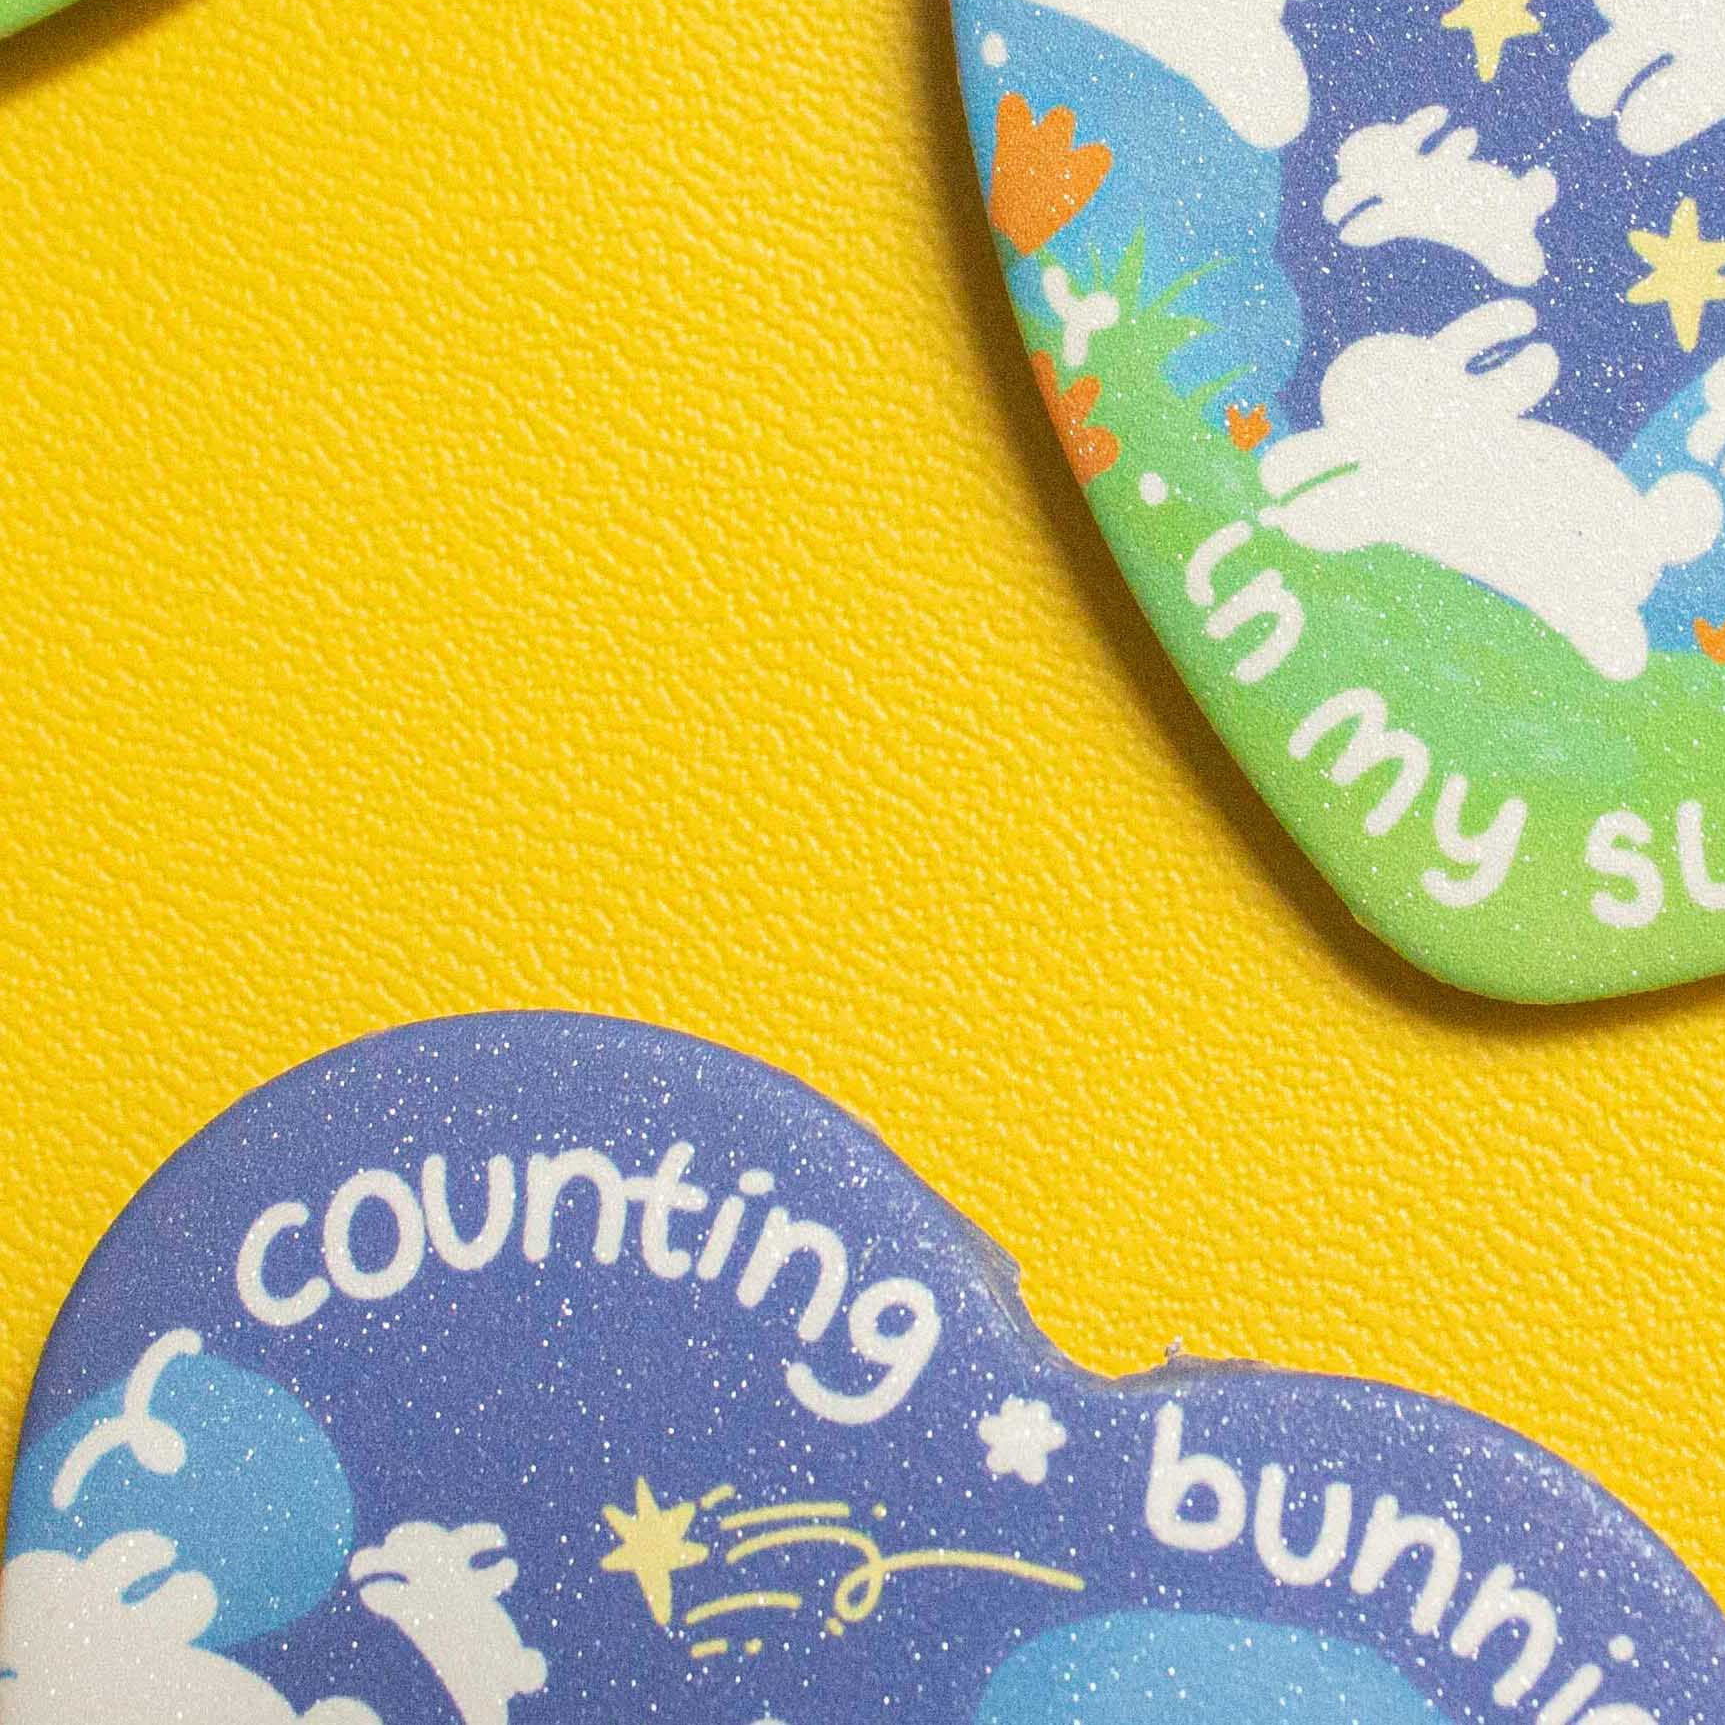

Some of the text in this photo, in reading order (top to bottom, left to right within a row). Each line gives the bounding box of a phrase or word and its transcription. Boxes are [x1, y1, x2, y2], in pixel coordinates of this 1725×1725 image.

[1288, 687, 1529, 908] my
[235, 1141, 1662, 1725] counting bunni
